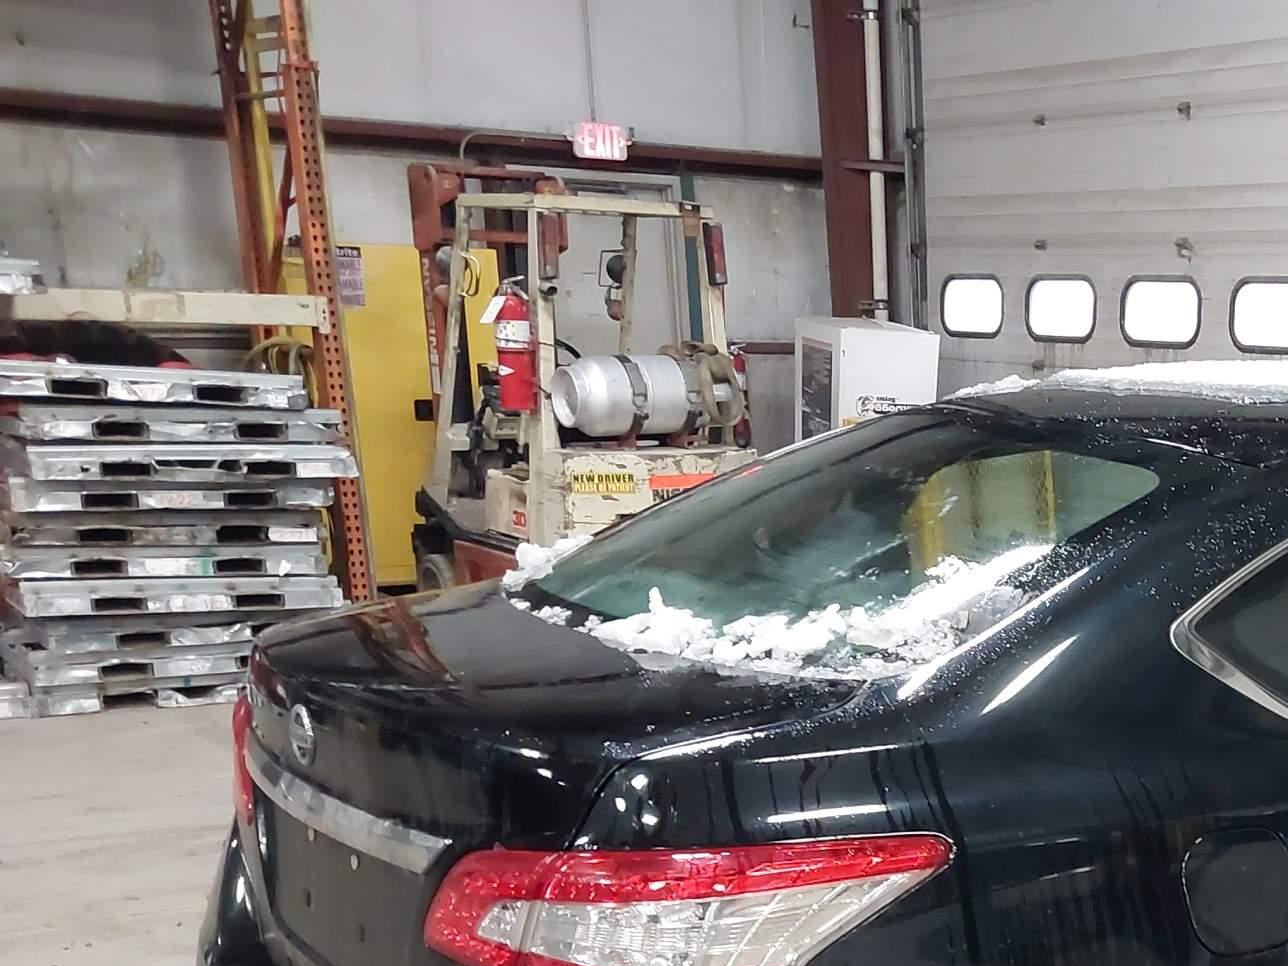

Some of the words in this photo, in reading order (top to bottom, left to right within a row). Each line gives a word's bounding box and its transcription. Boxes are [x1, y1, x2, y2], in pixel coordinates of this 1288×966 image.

[584, 122, 621, 159] EXIT
[573, 473, 595, 483] NEW
[597, 473, 634, 483] DRIVER
